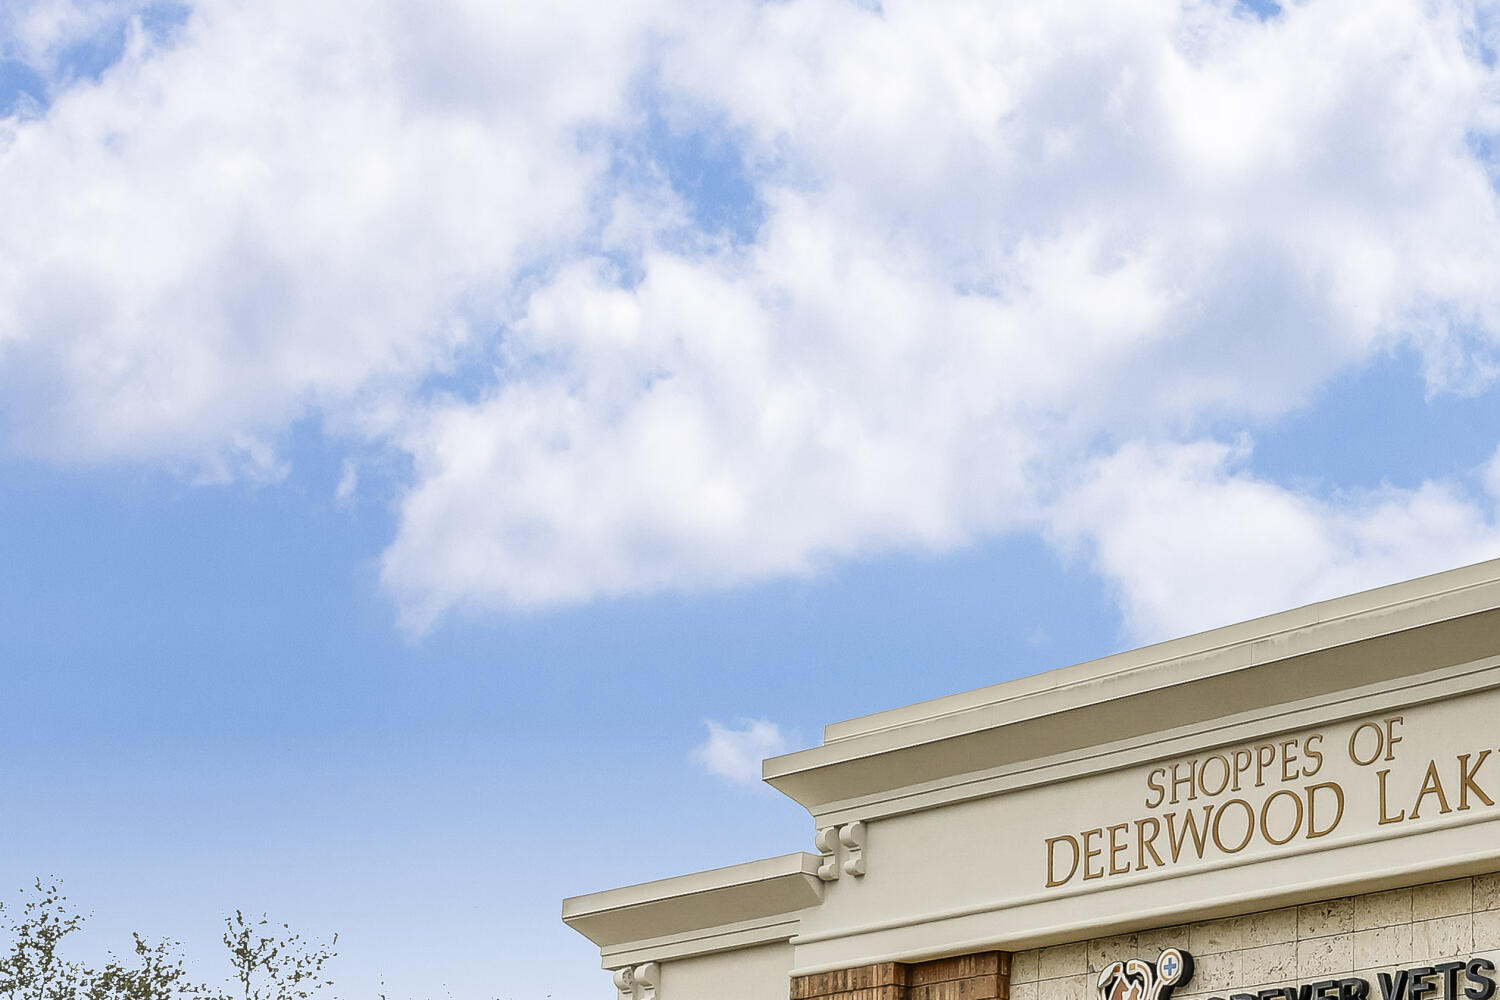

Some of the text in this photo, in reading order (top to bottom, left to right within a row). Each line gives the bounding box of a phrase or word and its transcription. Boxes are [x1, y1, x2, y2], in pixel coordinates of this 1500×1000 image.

[1145, 716, 1404, 809] SHOPPES OF
[1044, 781, 1345, 888] DEERWOOD
